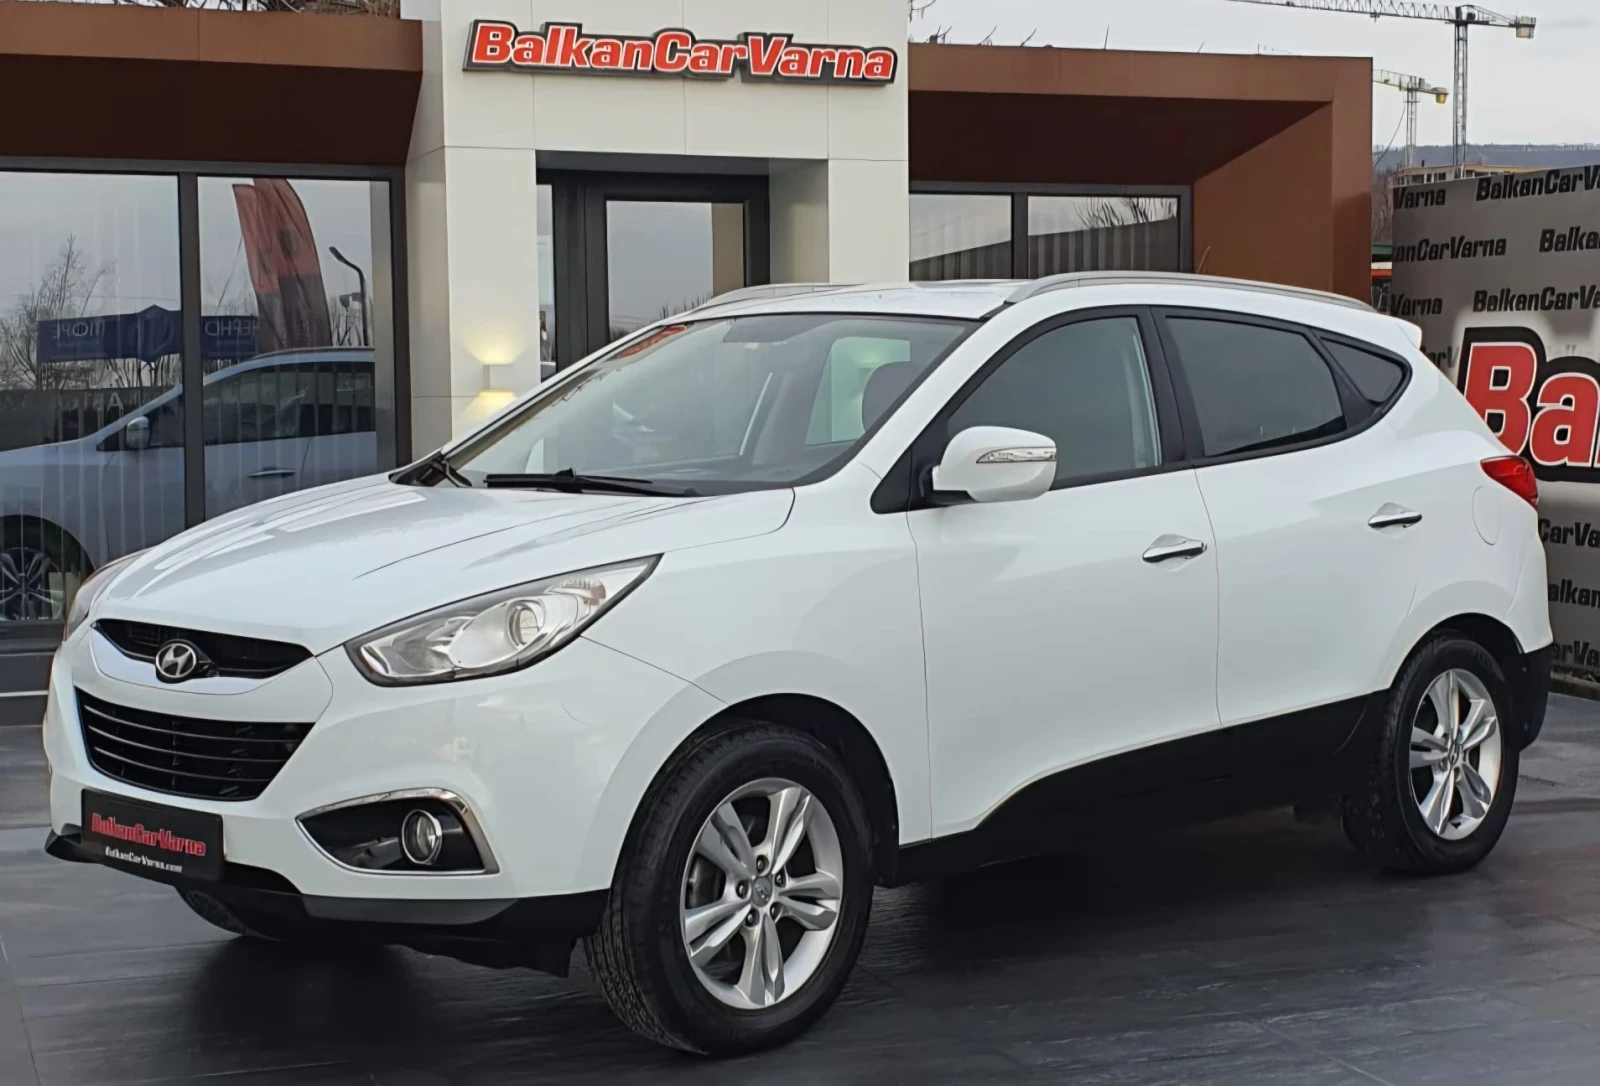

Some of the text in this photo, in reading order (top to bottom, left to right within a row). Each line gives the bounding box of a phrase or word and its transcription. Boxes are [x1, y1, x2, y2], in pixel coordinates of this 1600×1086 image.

[469, 22, 896, 82] BalkanCarVarna
[1539, 225, 1600, 252] Balka
[1460, 336, 1600, 471] Ba
[91, 812, 207, 857] BalkanCarVarna
